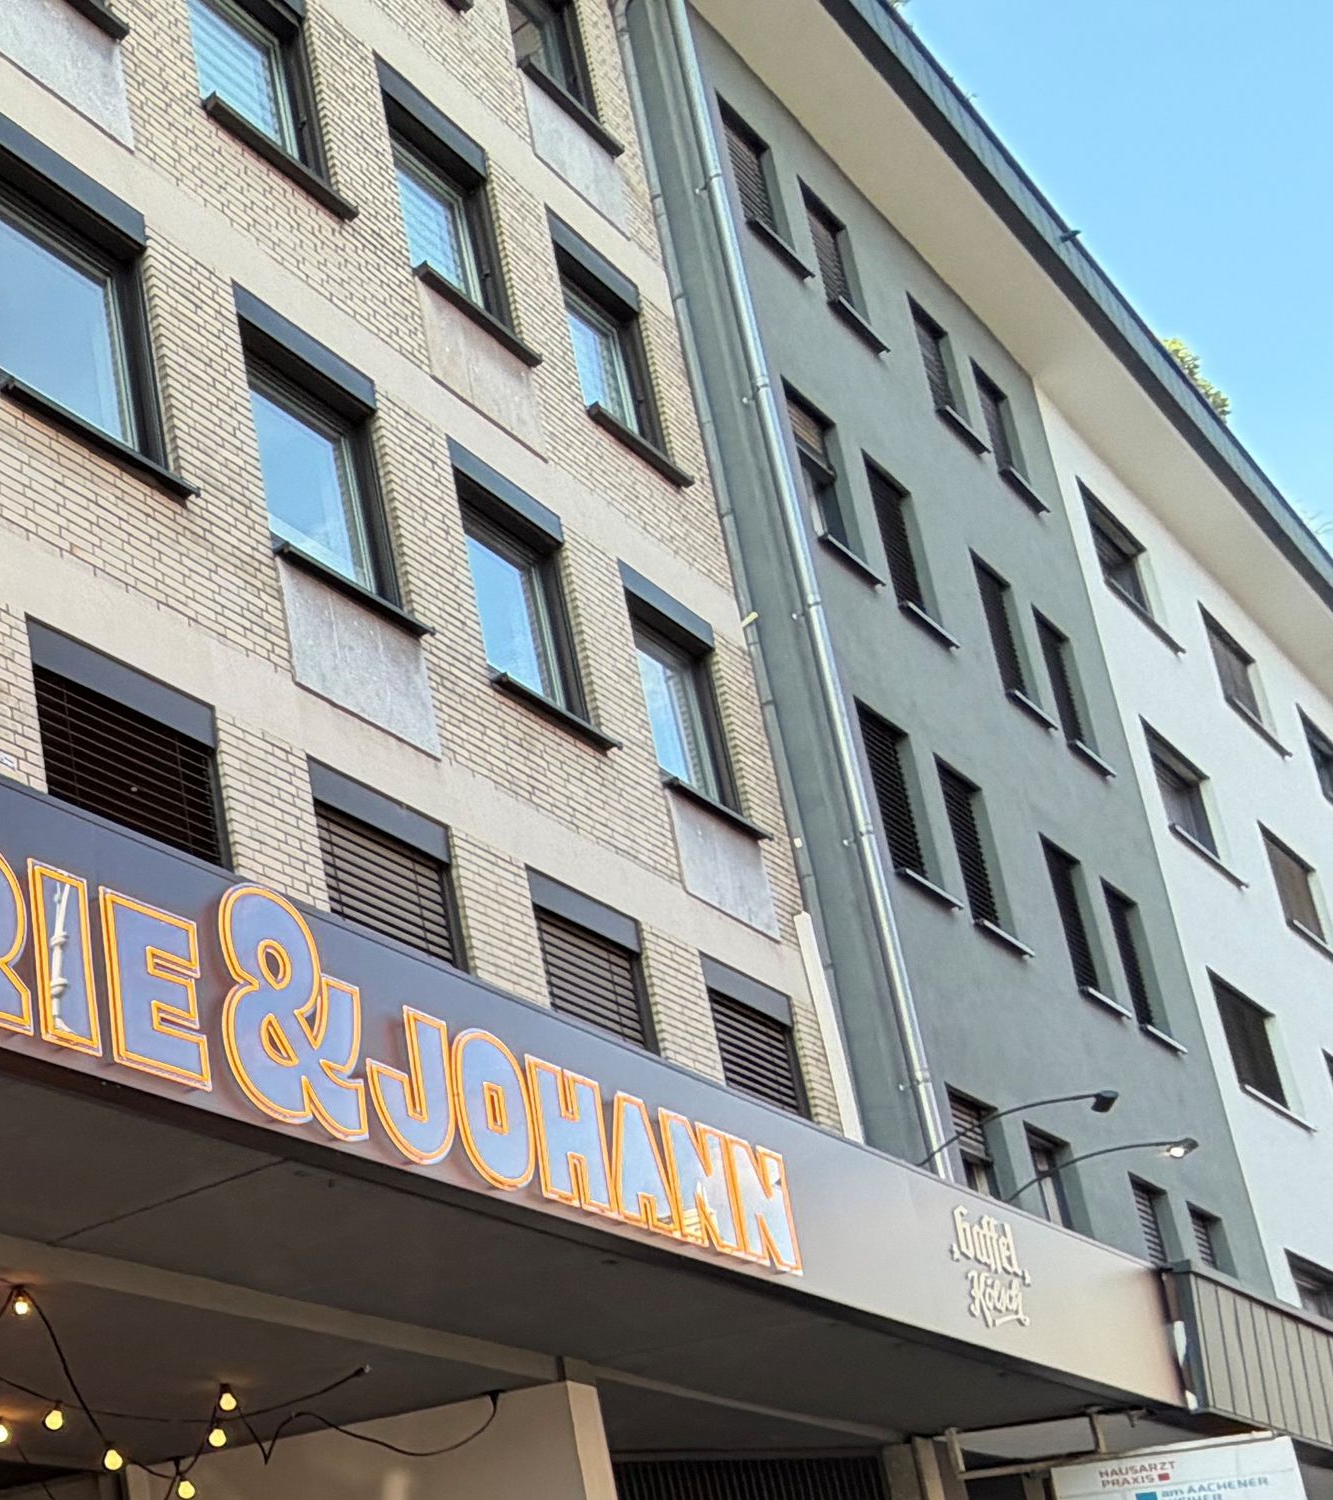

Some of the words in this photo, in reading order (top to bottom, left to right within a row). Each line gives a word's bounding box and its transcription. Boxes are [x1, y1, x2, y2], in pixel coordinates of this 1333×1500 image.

[952, 1205, 1023, 1277] Gaffel
[967, 1269, 1030, 1328] Kölsch
[1098, 1461, 1175, 1478] HAUSARZT
[1100, 1474, 1155, 1488] PRAXIS
[1186, 1476, 1269, 1494] AACHENER
